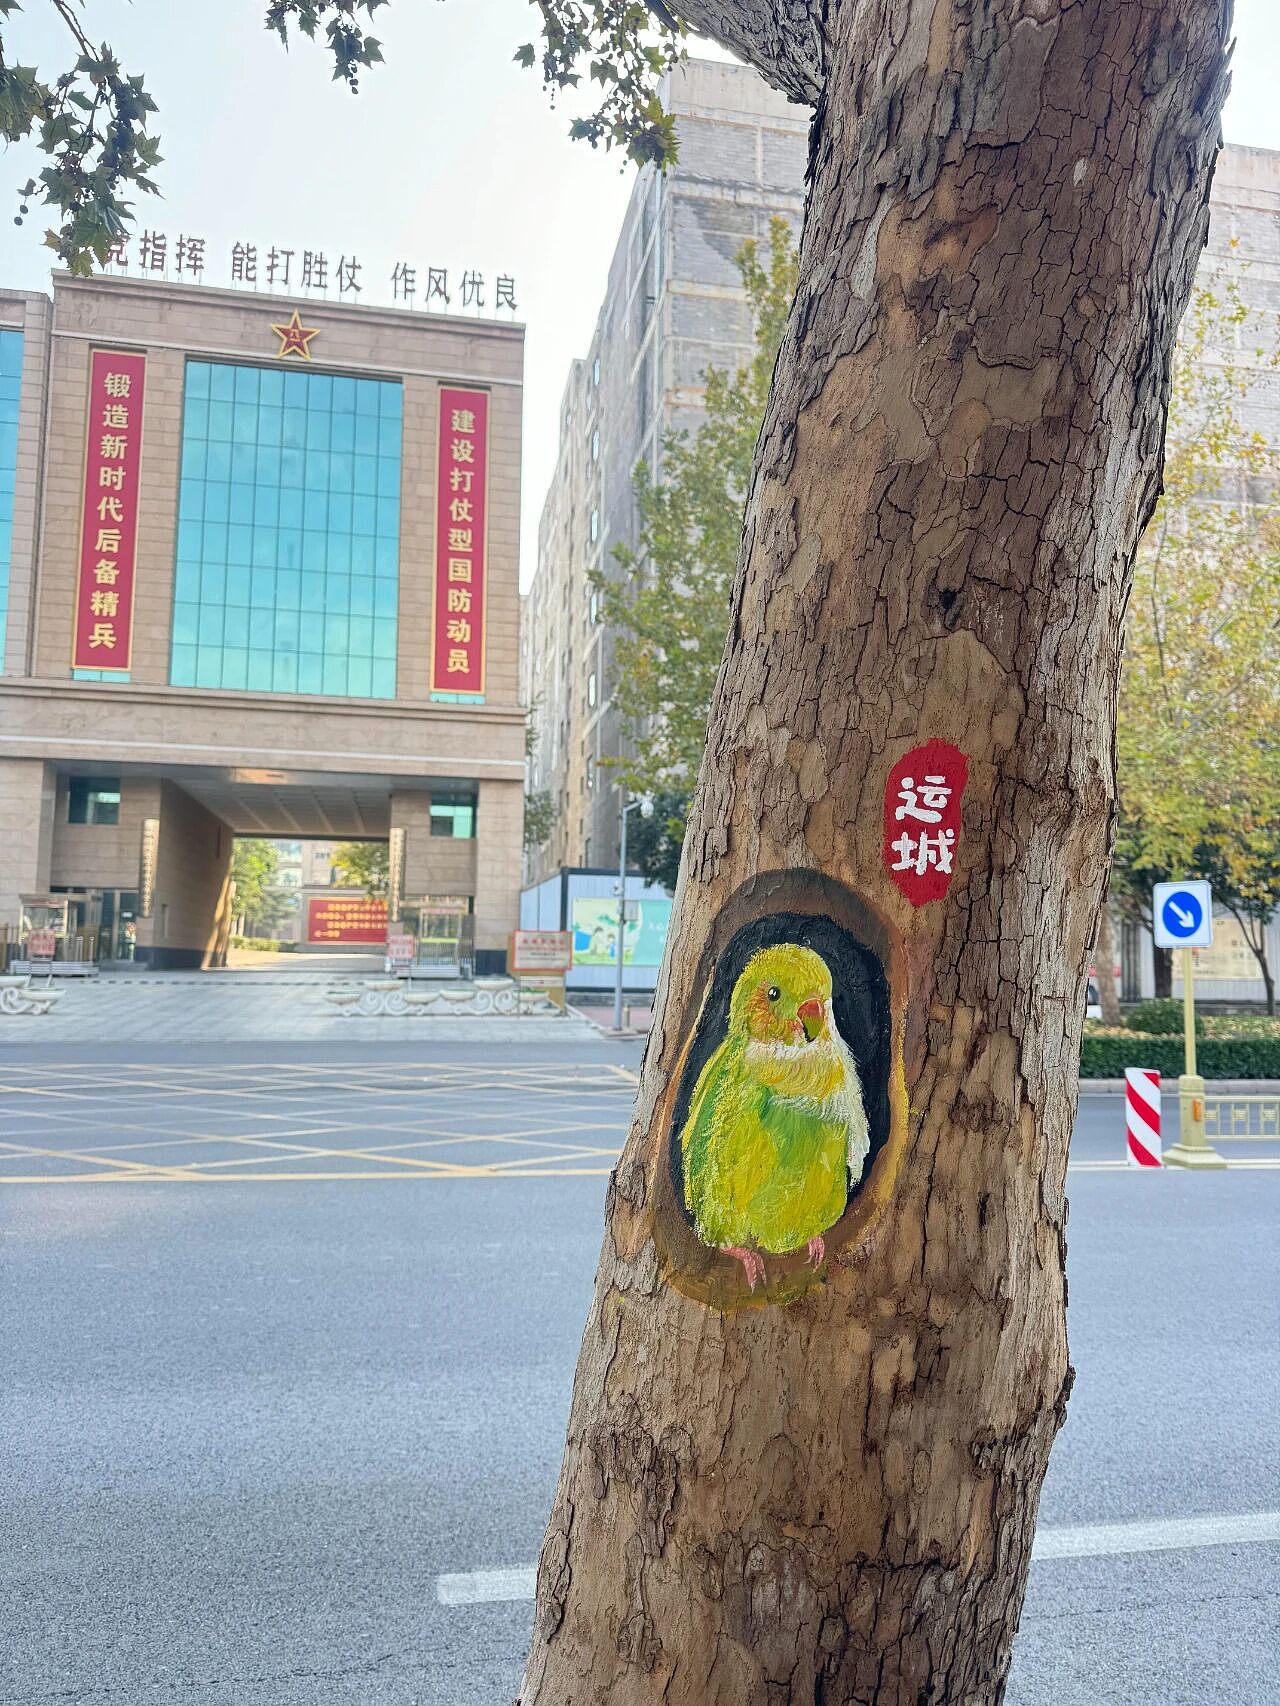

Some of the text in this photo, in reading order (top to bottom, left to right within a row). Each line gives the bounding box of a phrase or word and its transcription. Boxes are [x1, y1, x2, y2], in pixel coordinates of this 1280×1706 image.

[232, 241, 361, 292] 能打胜仗
[391, 261, 518, 310] 作风优良
[88, 372, 131, 650] 锻造新时代后备精兵
[447, 408, 475, 674] 建设打仗型国防动员
[891, 775, 955, 876] 运城
